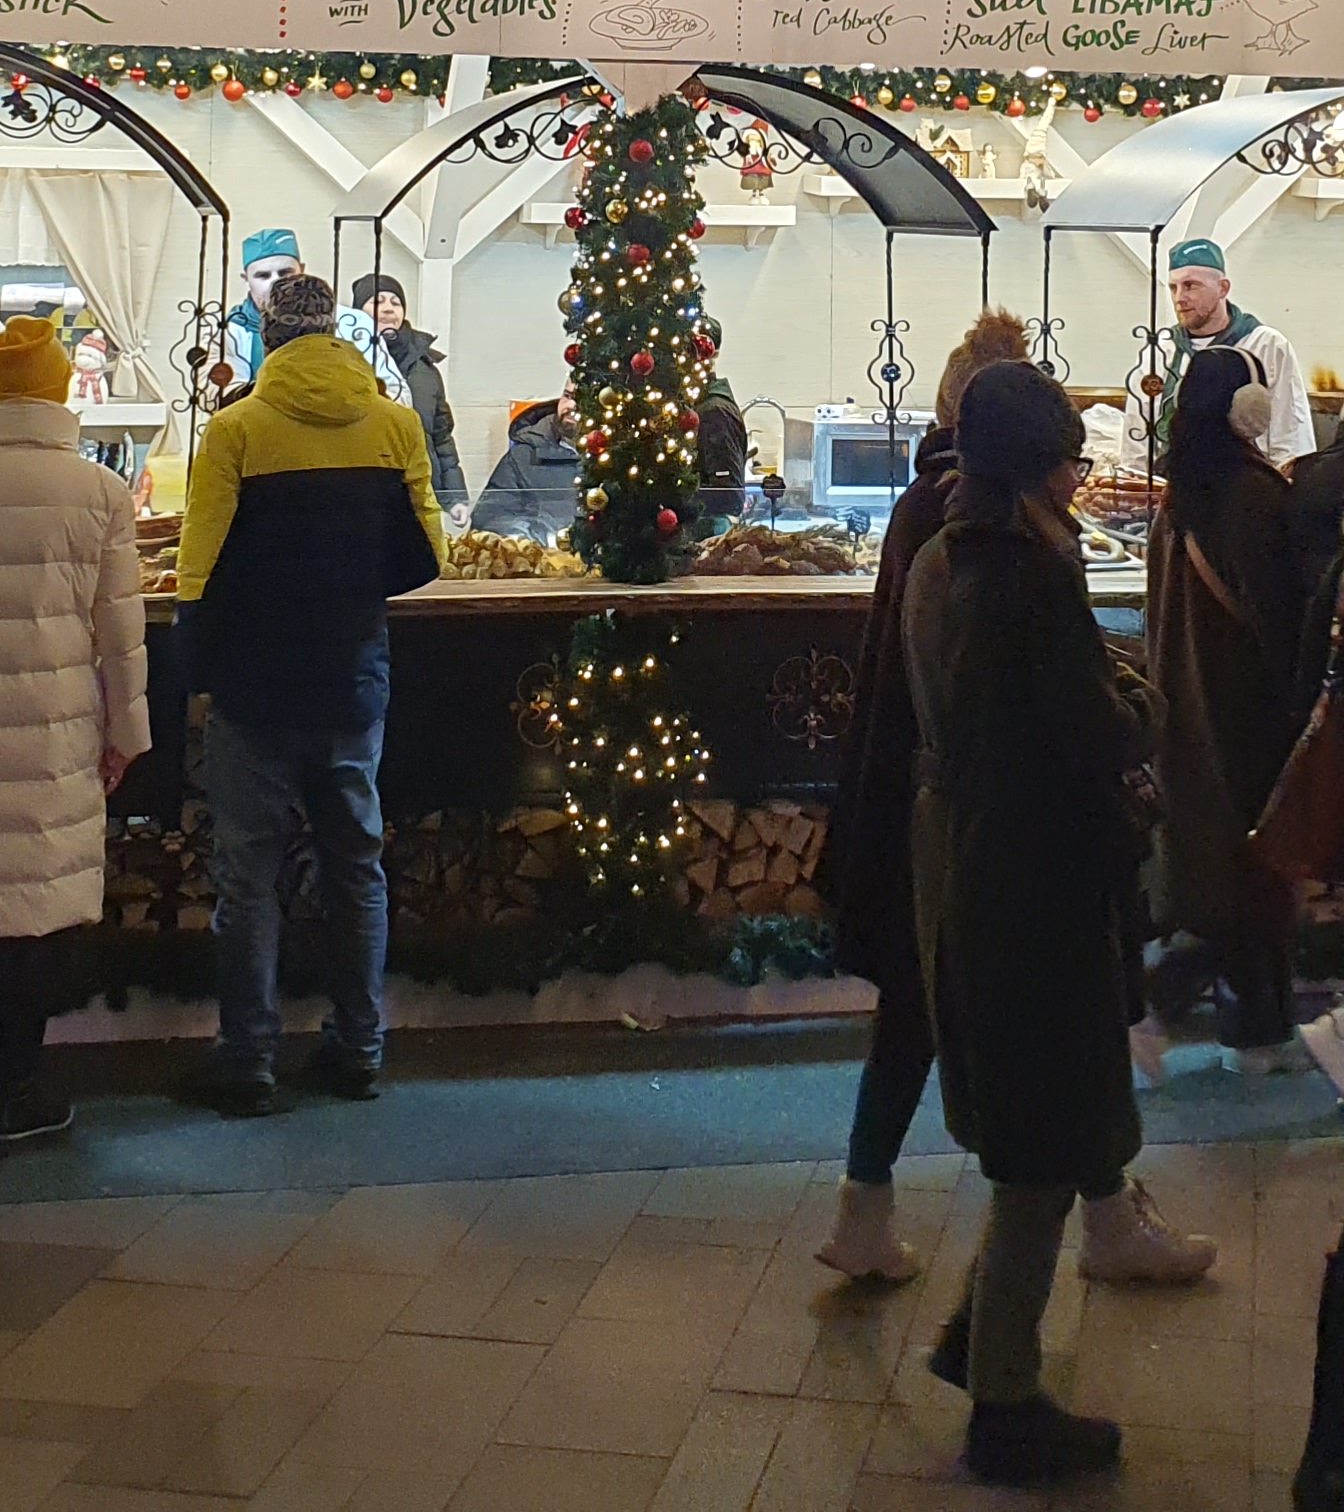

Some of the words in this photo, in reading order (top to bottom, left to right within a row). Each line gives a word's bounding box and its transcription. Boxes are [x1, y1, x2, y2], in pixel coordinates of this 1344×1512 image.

[329, 3, 368, 17] WITH
[813, 4, 927, 45] Cabbage
[945, 22, 1056, 56] Roasted
[1062, 20, 1141, 51] GOOSE
[1141, 23, 1229, 55] Liver
